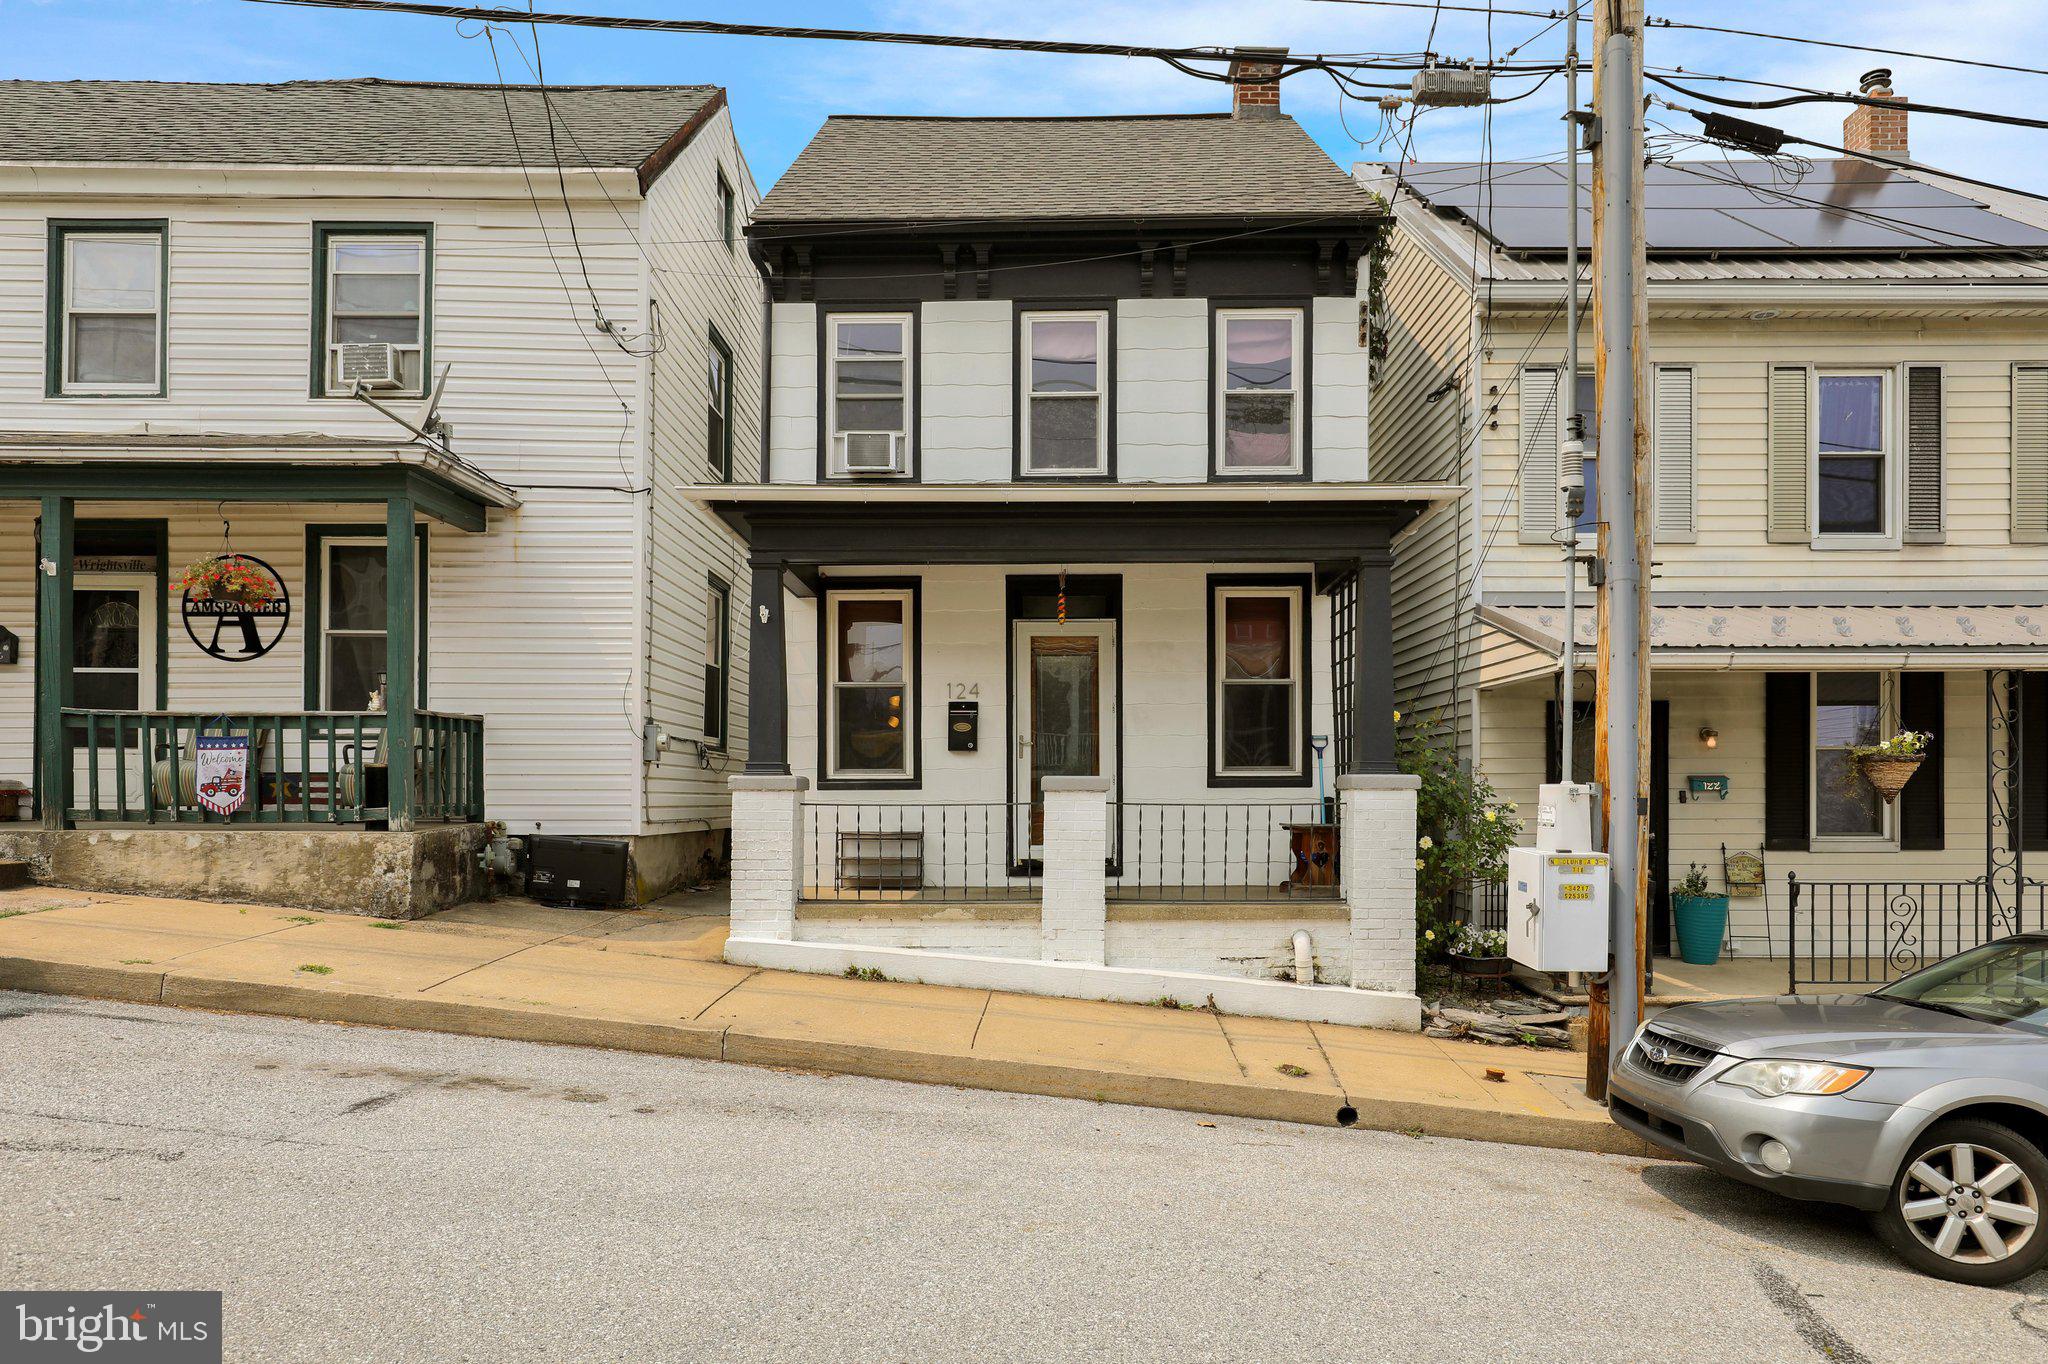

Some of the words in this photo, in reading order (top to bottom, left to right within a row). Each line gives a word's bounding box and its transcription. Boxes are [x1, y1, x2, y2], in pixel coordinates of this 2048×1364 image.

[79, 559, 146, 572] Wrightsville
[191, 601, 281, 613] AMSPACER
[946, 682, 980, 700] 124
[200, 751, 245, 767] Welcome
[1703, 781, 1721, 791] 122
